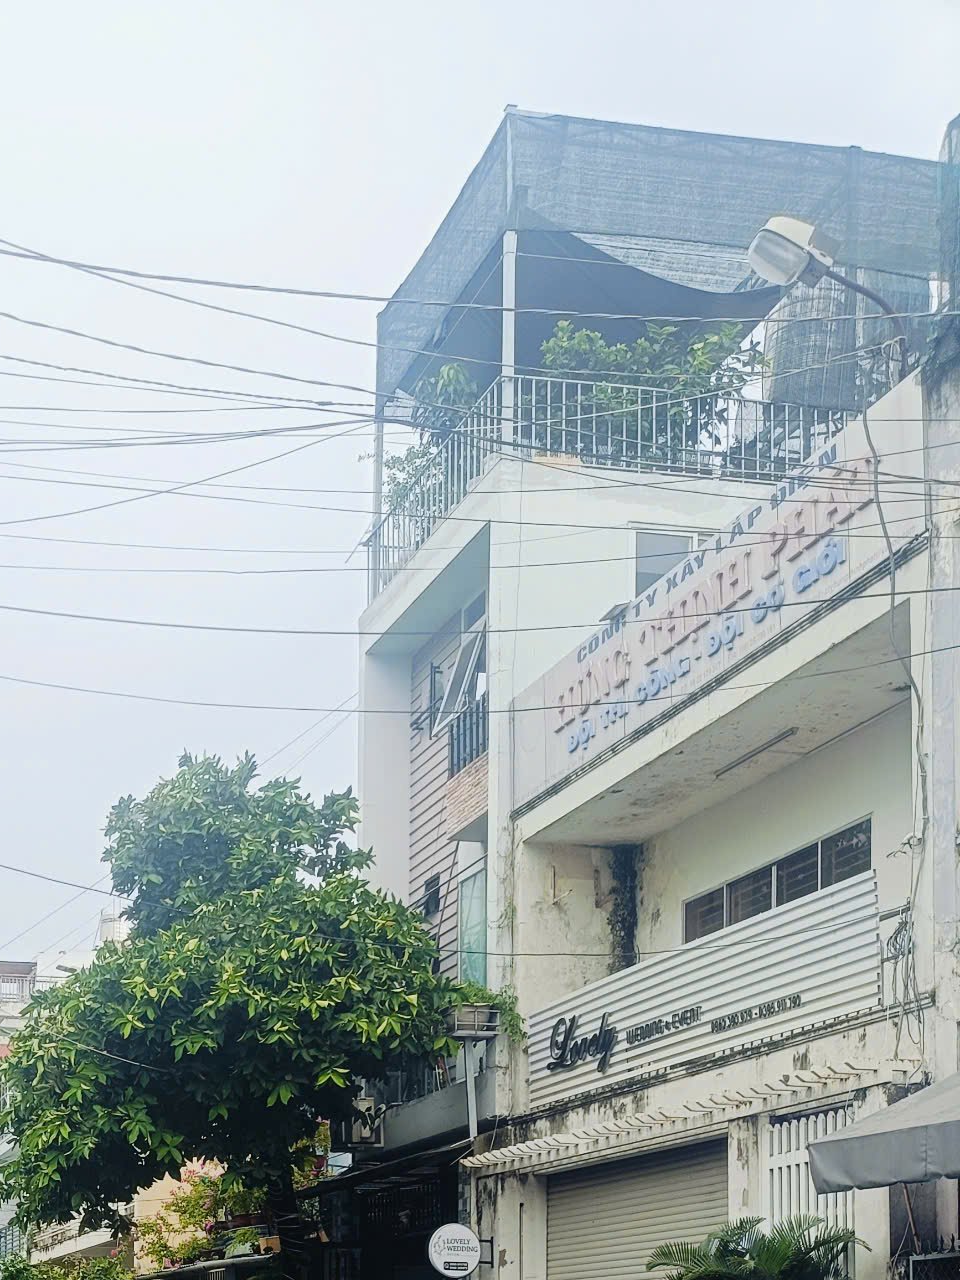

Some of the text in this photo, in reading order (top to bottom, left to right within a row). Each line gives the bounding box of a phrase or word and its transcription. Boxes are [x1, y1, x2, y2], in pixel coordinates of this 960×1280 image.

[632, 587, 657, 617] TY
[666, 553, 706, 595] XÂY
[568, 718, 596, 754] ĐỘI
[634, 657, 690, 706] CÔNG
[707, 611, 744, 658] ĐỘI
[547, 1012, 618, 1074] Lovely
[626, 1018, 664, 1045] WEDDING
[672, 1006, 702, 1029] EVENT
